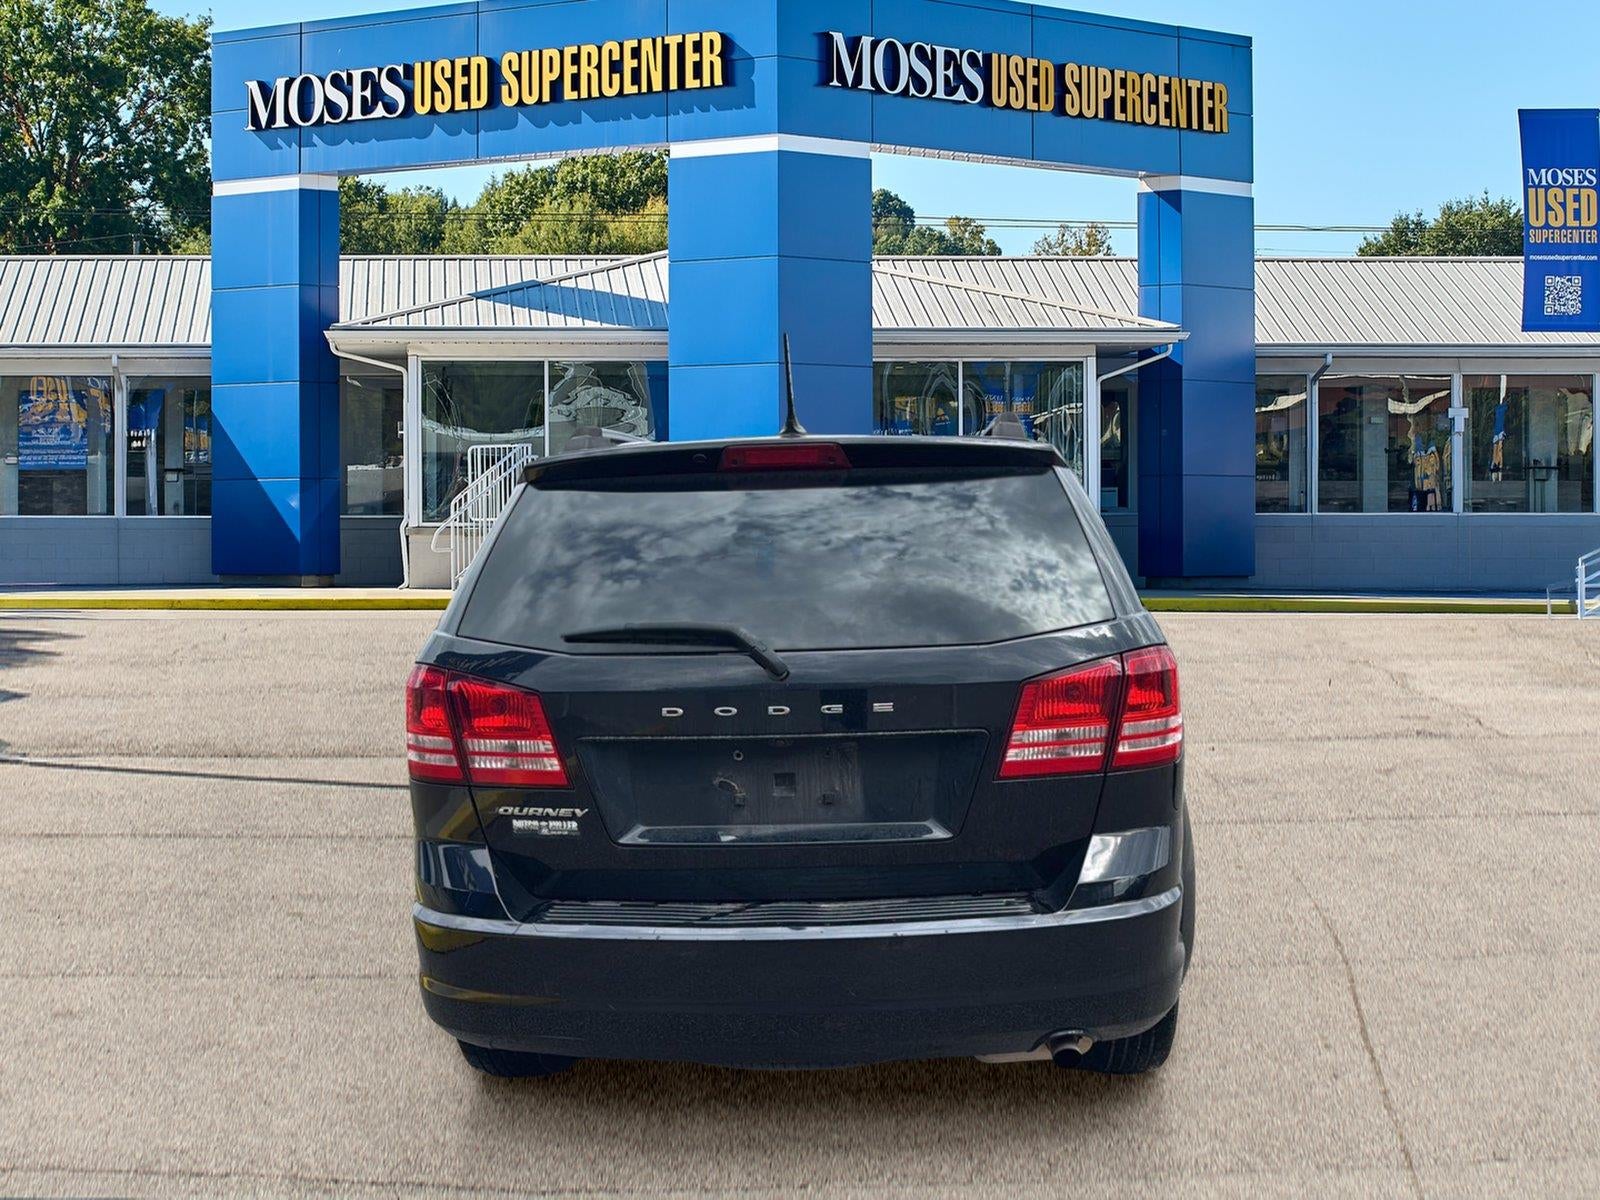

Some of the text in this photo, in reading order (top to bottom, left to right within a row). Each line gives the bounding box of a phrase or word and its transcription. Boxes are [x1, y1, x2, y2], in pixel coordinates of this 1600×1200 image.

[244, 31, 723, 131] MOSES USED SUPERCENTER
[829, 31, 1230, 133] MOSES USED SUPERCENTER
[1527, 168, 1597, 186] MOSES
[1527, 188, 1598, 227] USED
[1529, 229, 1598, 244] SUPERCENTER
[661, 702, 894, 718] DODGE
